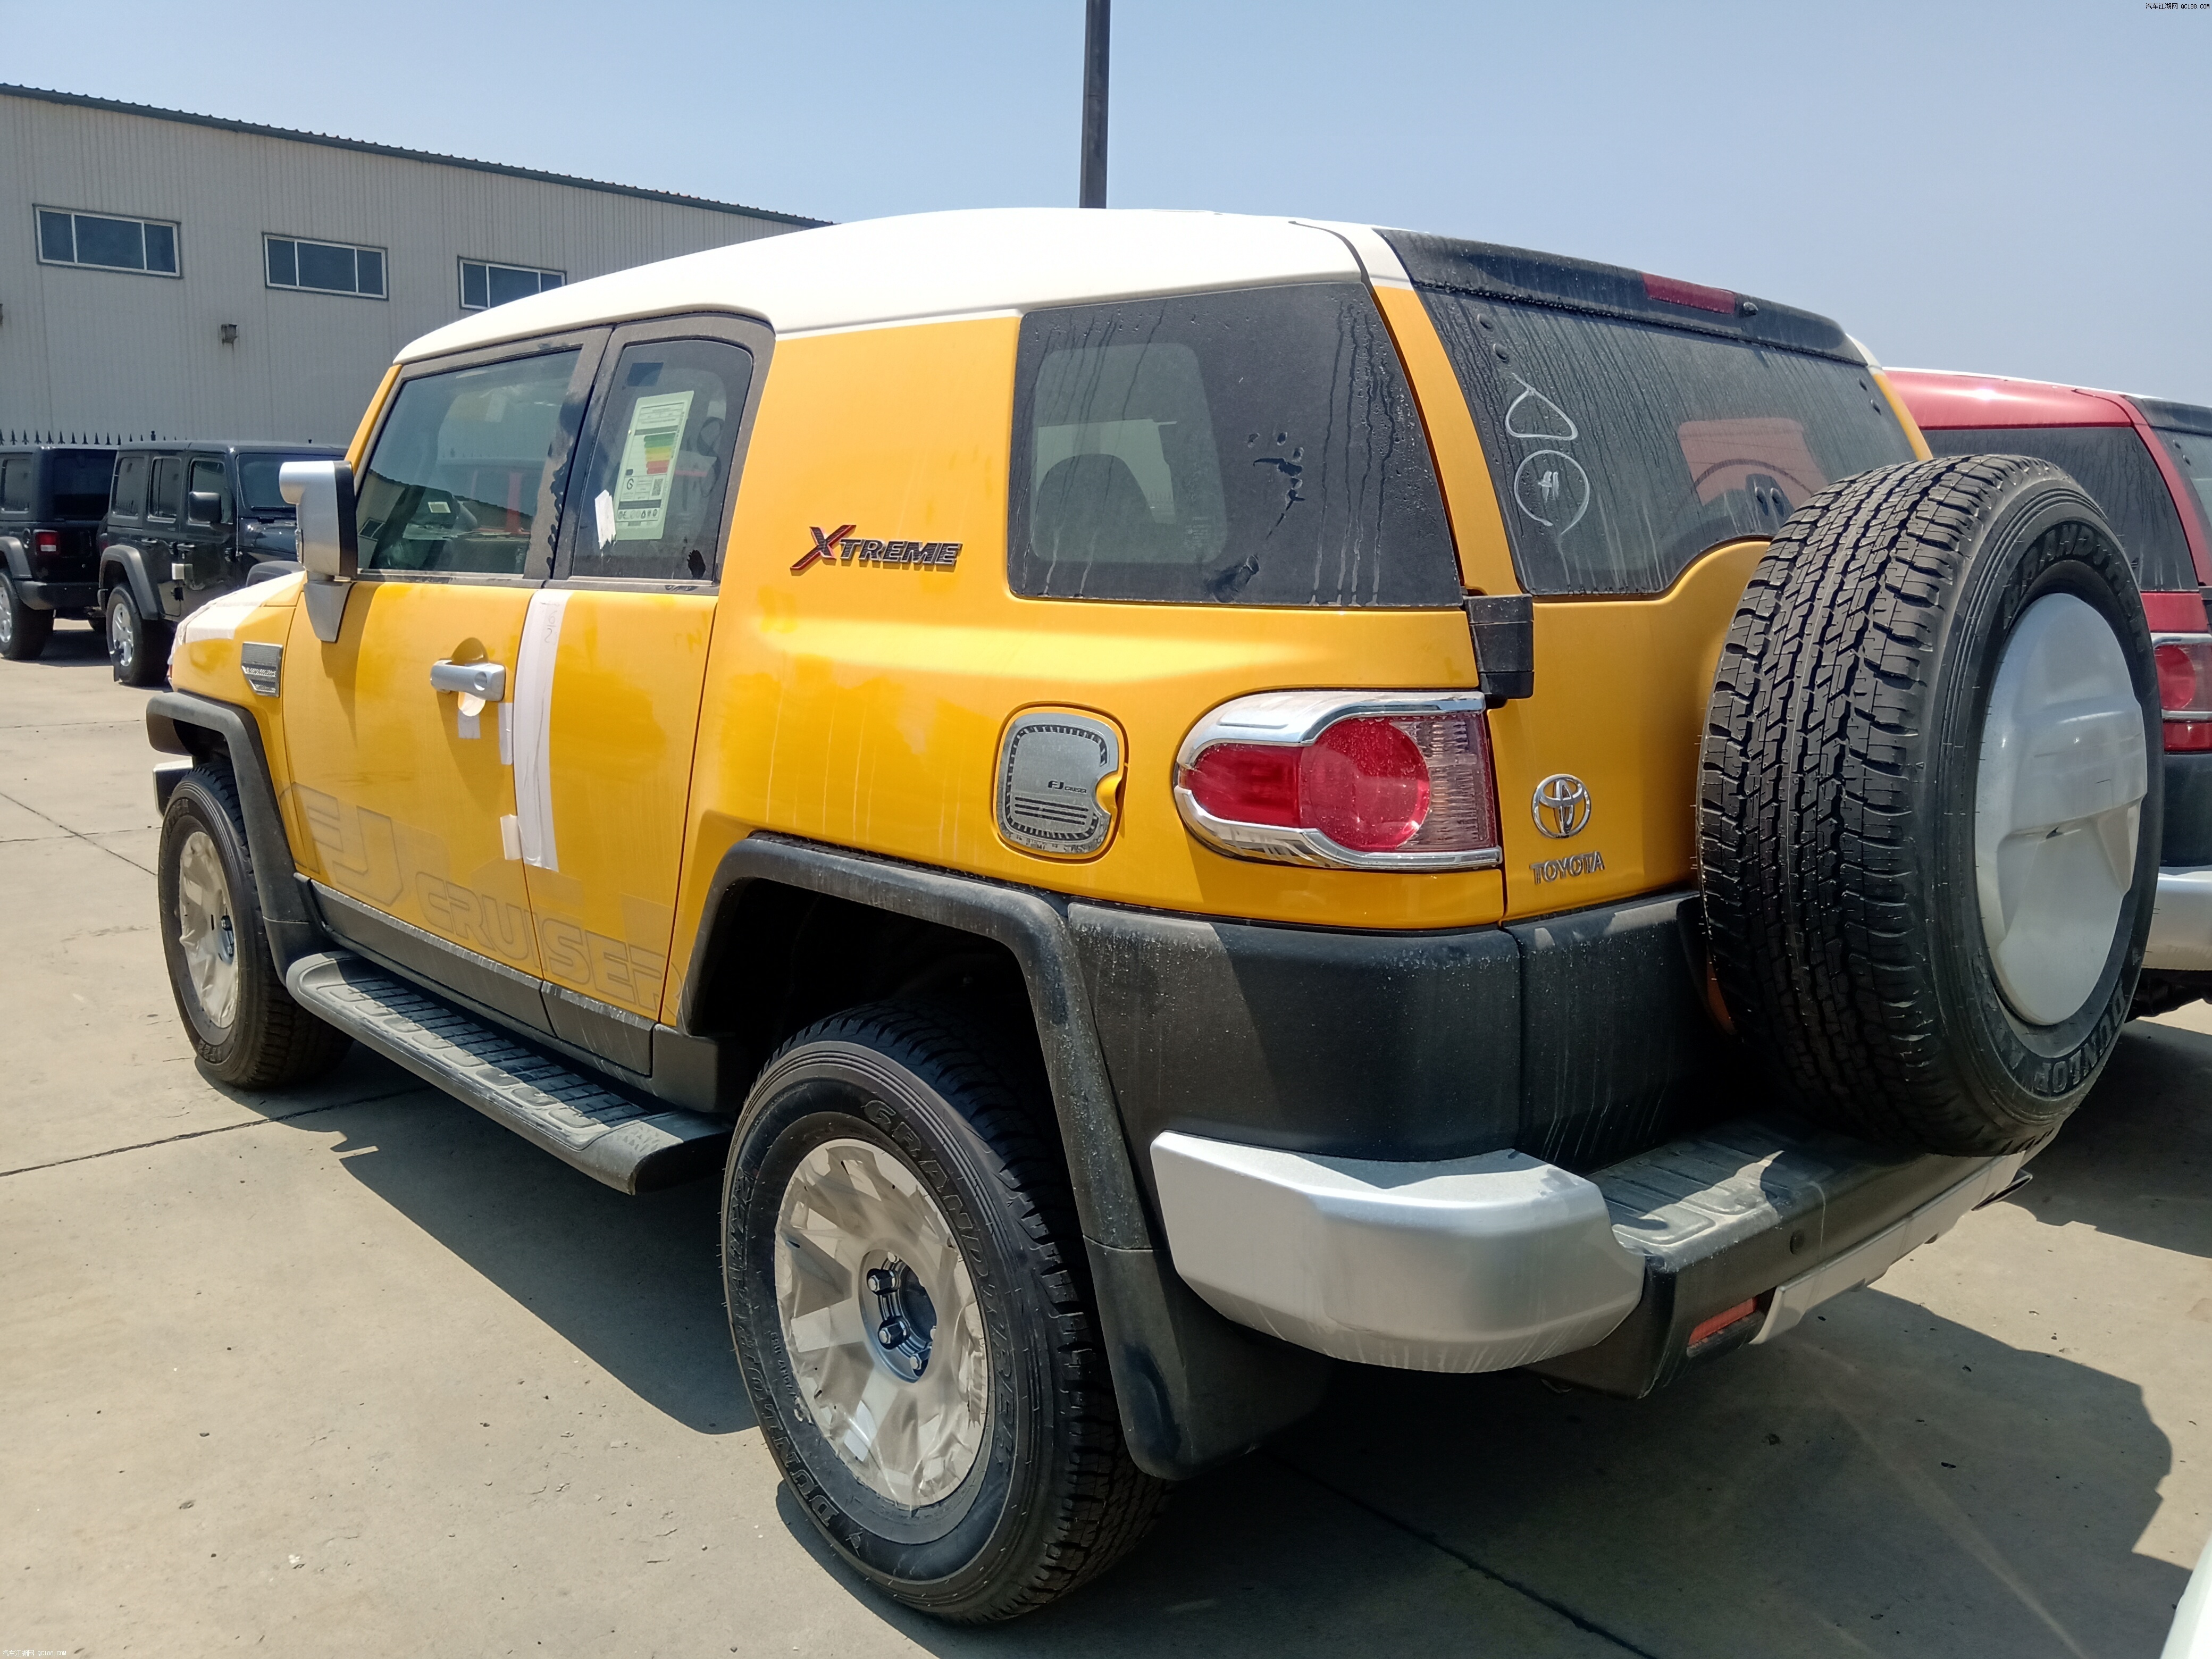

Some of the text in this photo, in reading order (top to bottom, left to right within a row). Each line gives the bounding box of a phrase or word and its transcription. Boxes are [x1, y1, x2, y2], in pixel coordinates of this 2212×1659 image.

[790, 524, 963, 571] XTREME
[1048, 780, 1065, 790] FJ
[279, 781, 683, 1017] FJ CRUISER
[1529, 851, 1605, 885] TOYOTA
[2034, 977, 2126, 1093] DUNLOP
[736, 1325, 840, 1527] DUNLOP
